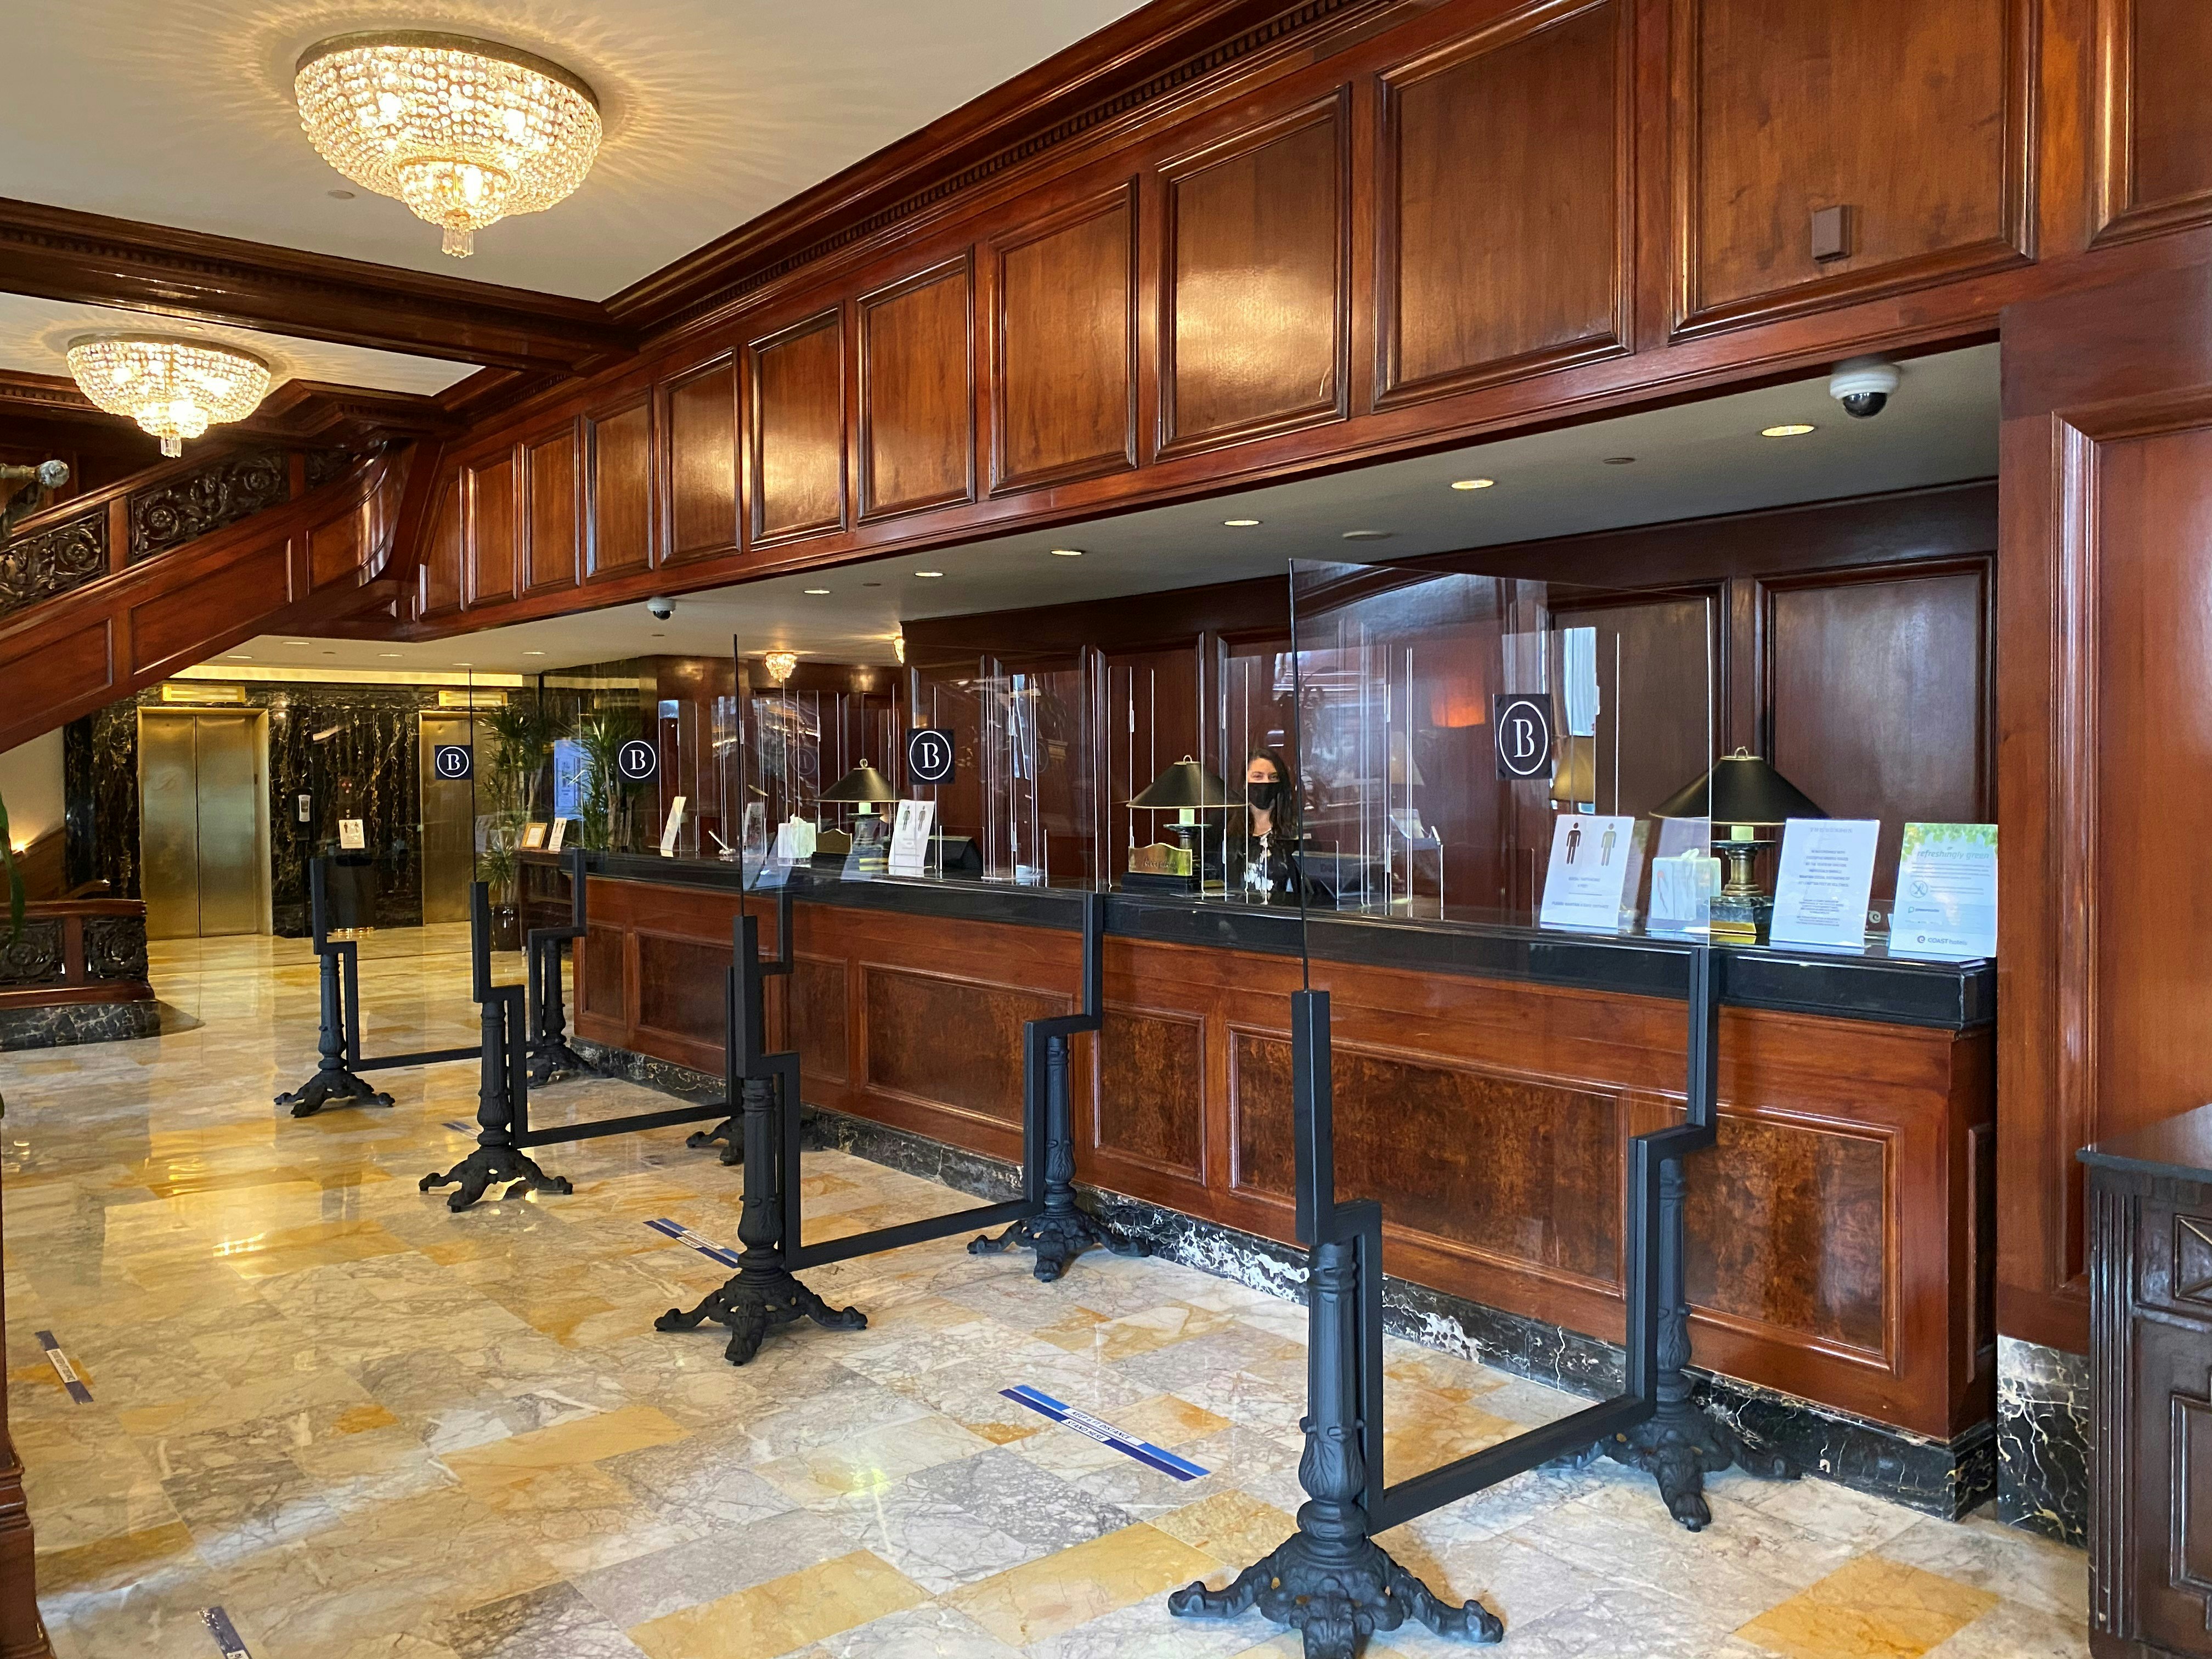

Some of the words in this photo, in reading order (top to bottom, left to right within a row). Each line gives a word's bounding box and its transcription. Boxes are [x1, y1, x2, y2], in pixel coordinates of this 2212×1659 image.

[1513, 719, 1535, 758] B
[445, 754, 460, 770] B
[629, 749, 646, 770] B
[921, 742, 940, 768] B
[1917, 849, 1964, 859] refreshingly
[1065, 1421, 1088, 1431] STAND
[1086, 1430, 1105, 1440] HERE
[1099, 1424, 1132, 1439] DISTANCE
